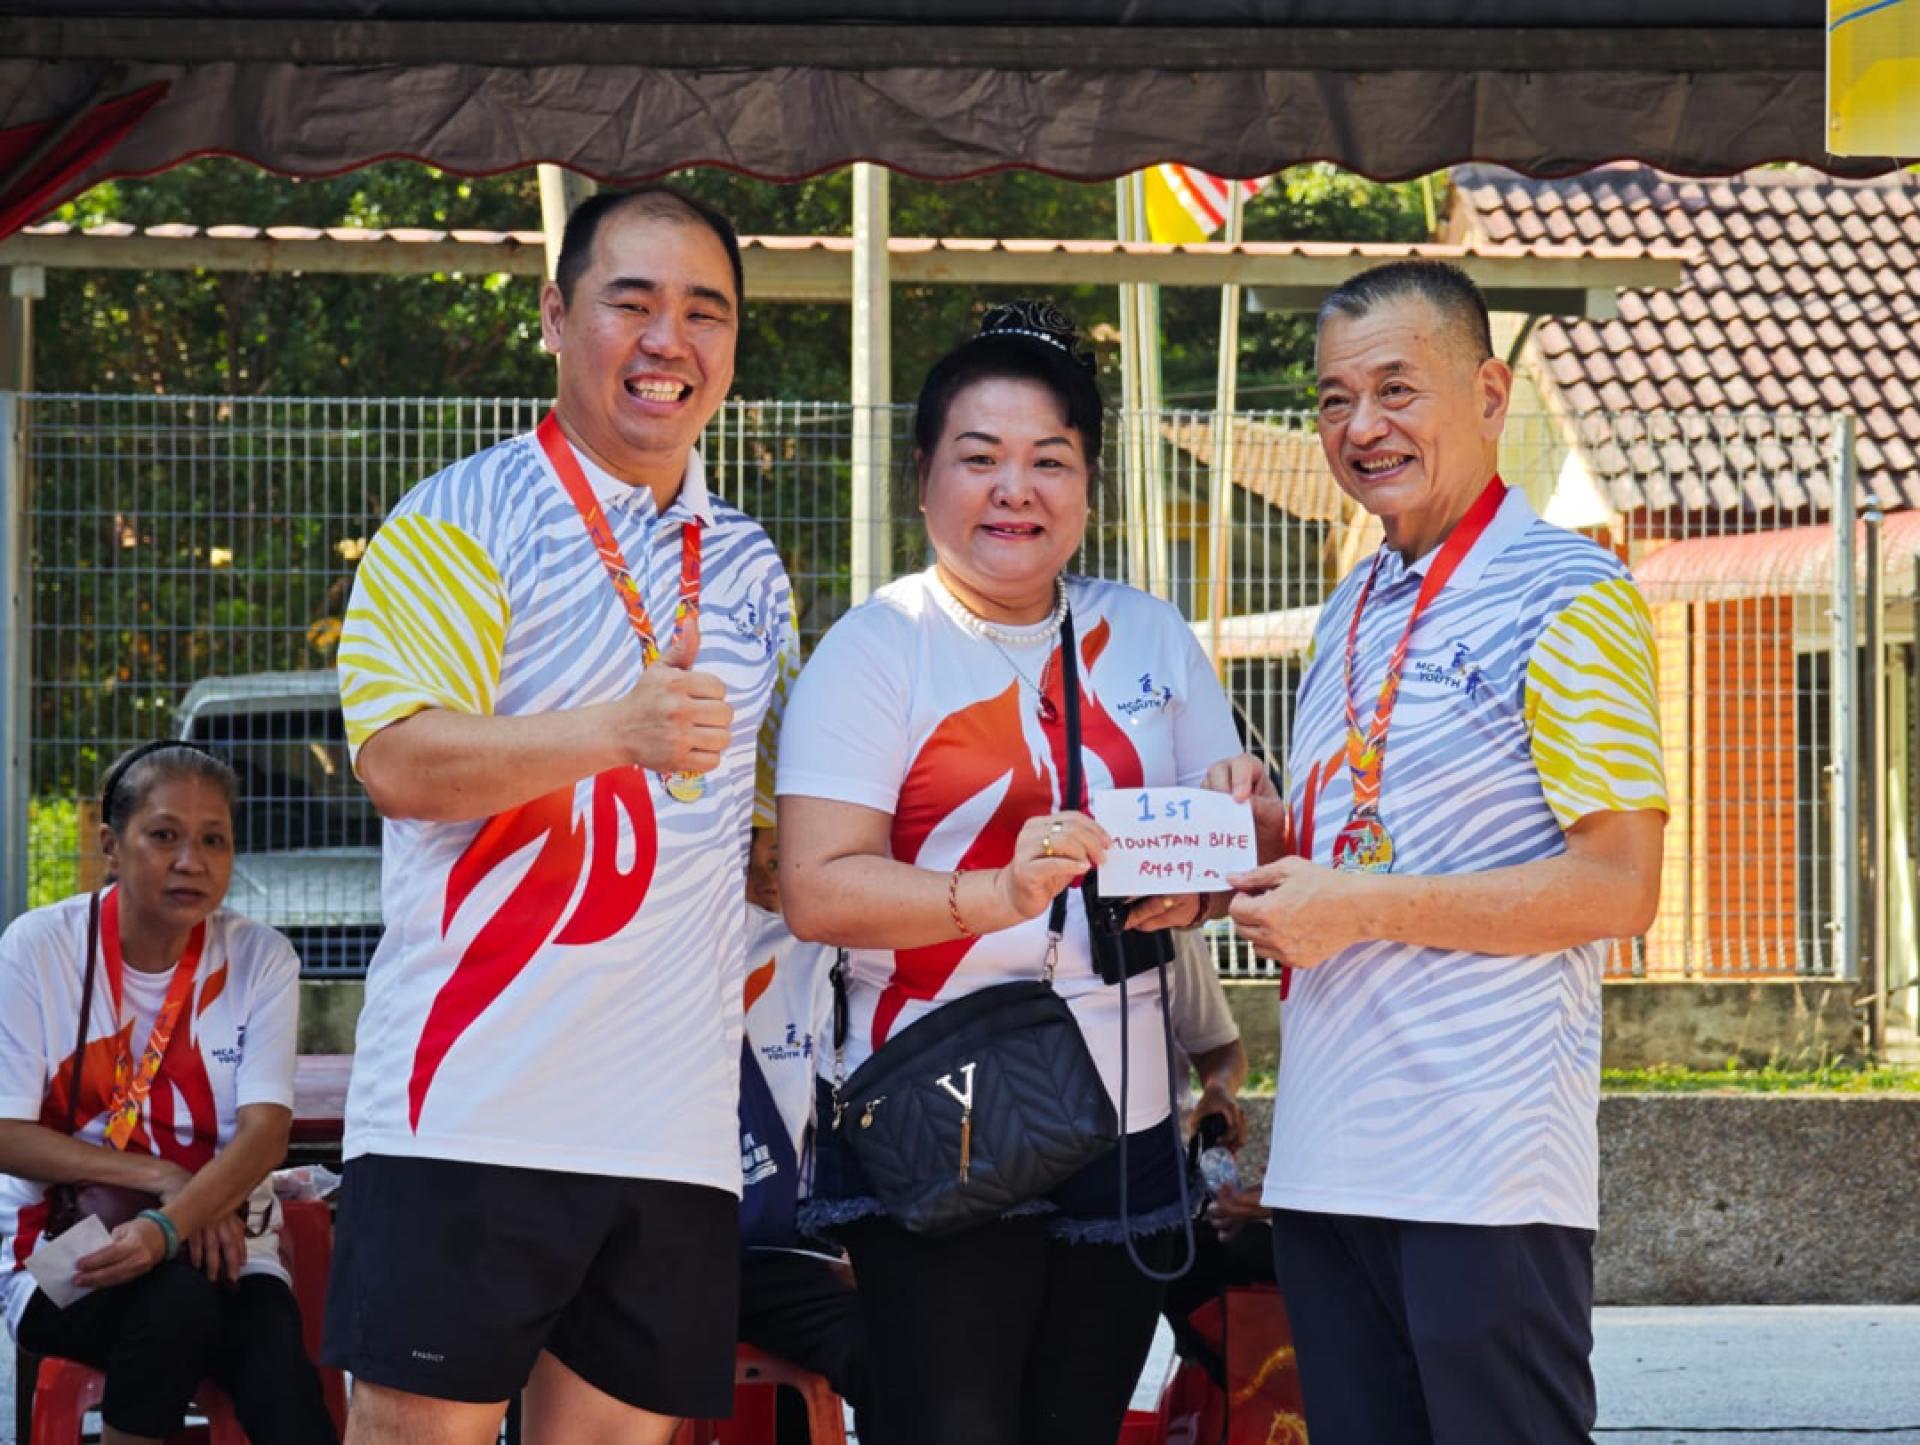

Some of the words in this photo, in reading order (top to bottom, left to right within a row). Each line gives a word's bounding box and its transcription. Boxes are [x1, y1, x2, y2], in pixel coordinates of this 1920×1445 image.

[1415, 661, 1442, 674] MCA
[1421, 672, 1461, 687] YOUTH
[1208, 831, 1249, 849] BIKE
[767, 1051, 800, 1060] YOUTH
